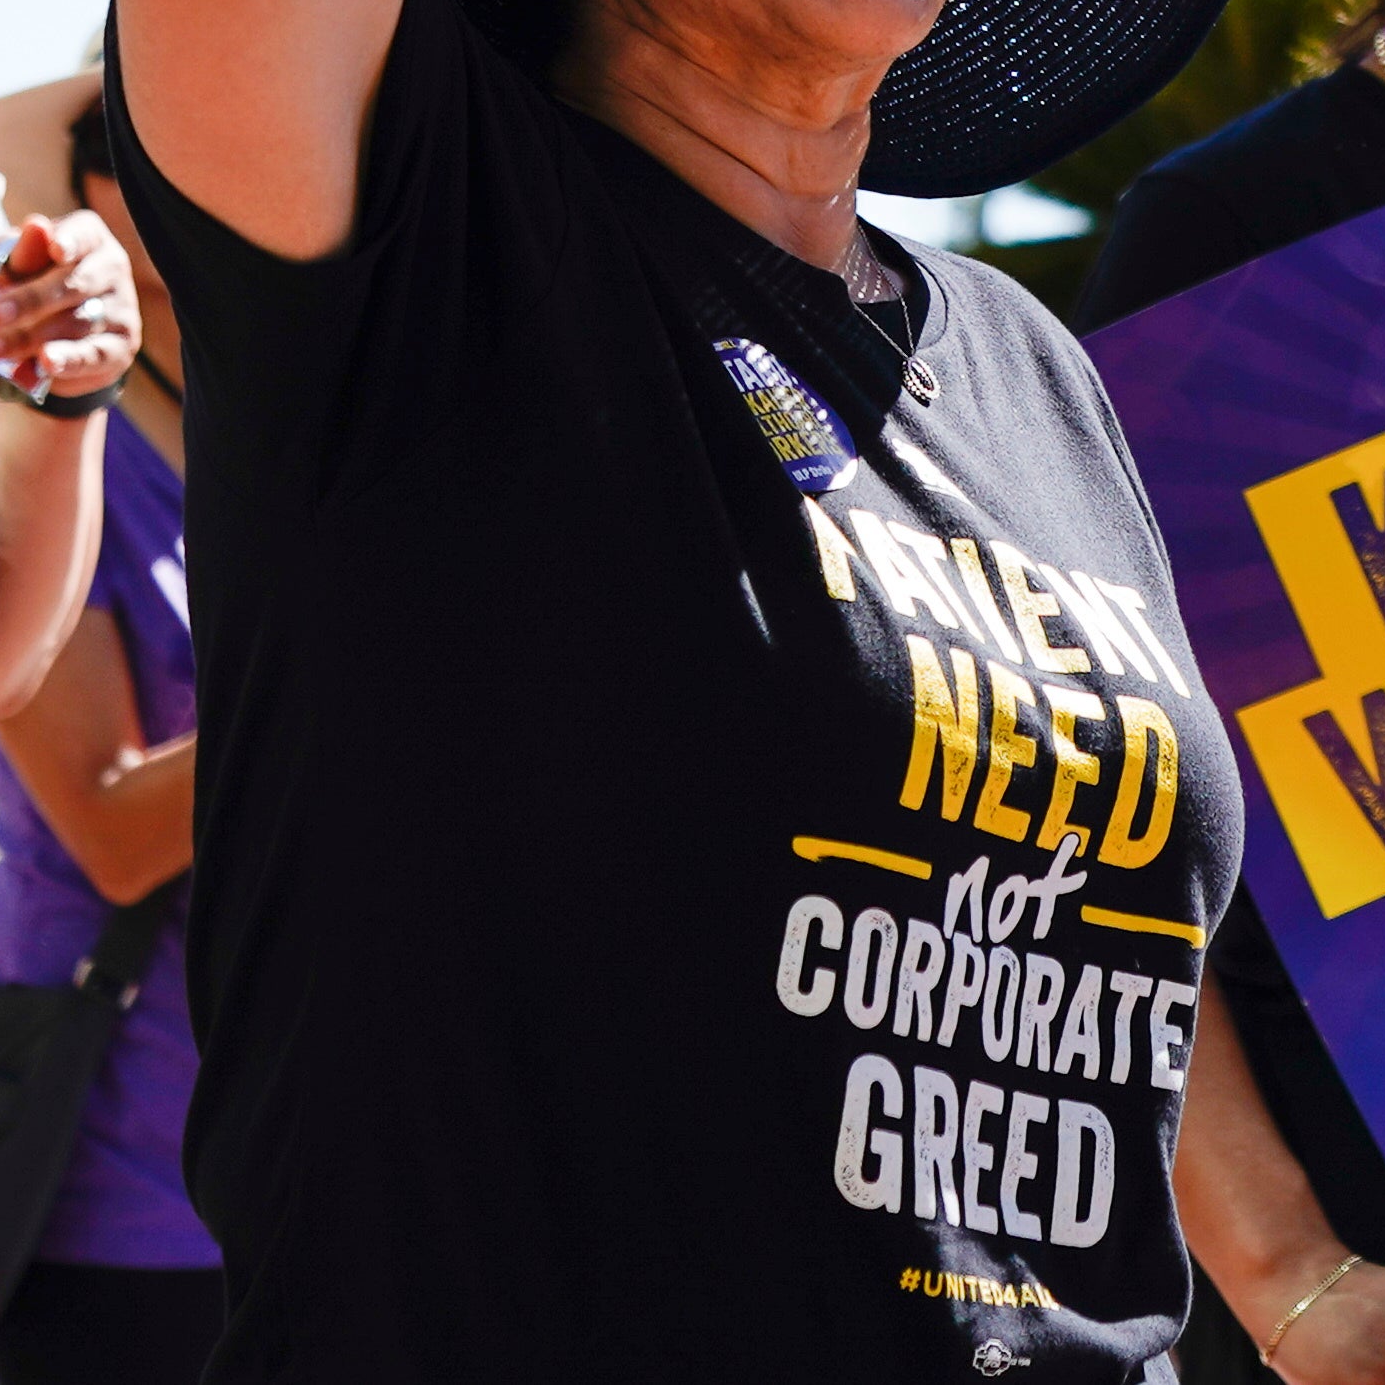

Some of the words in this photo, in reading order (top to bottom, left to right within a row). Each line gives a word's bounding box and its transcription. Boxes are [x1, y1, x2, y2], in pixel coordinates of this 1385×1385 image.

[899, 634, 1179, 869] NEED
[944, 833, 1087, 943] not
[776, 894, 1196, 1093] CORPORATE
[834, 1053, 1115, 1249] GREED
[899, 1267, 1060, 1311] #UNITED4ALL
